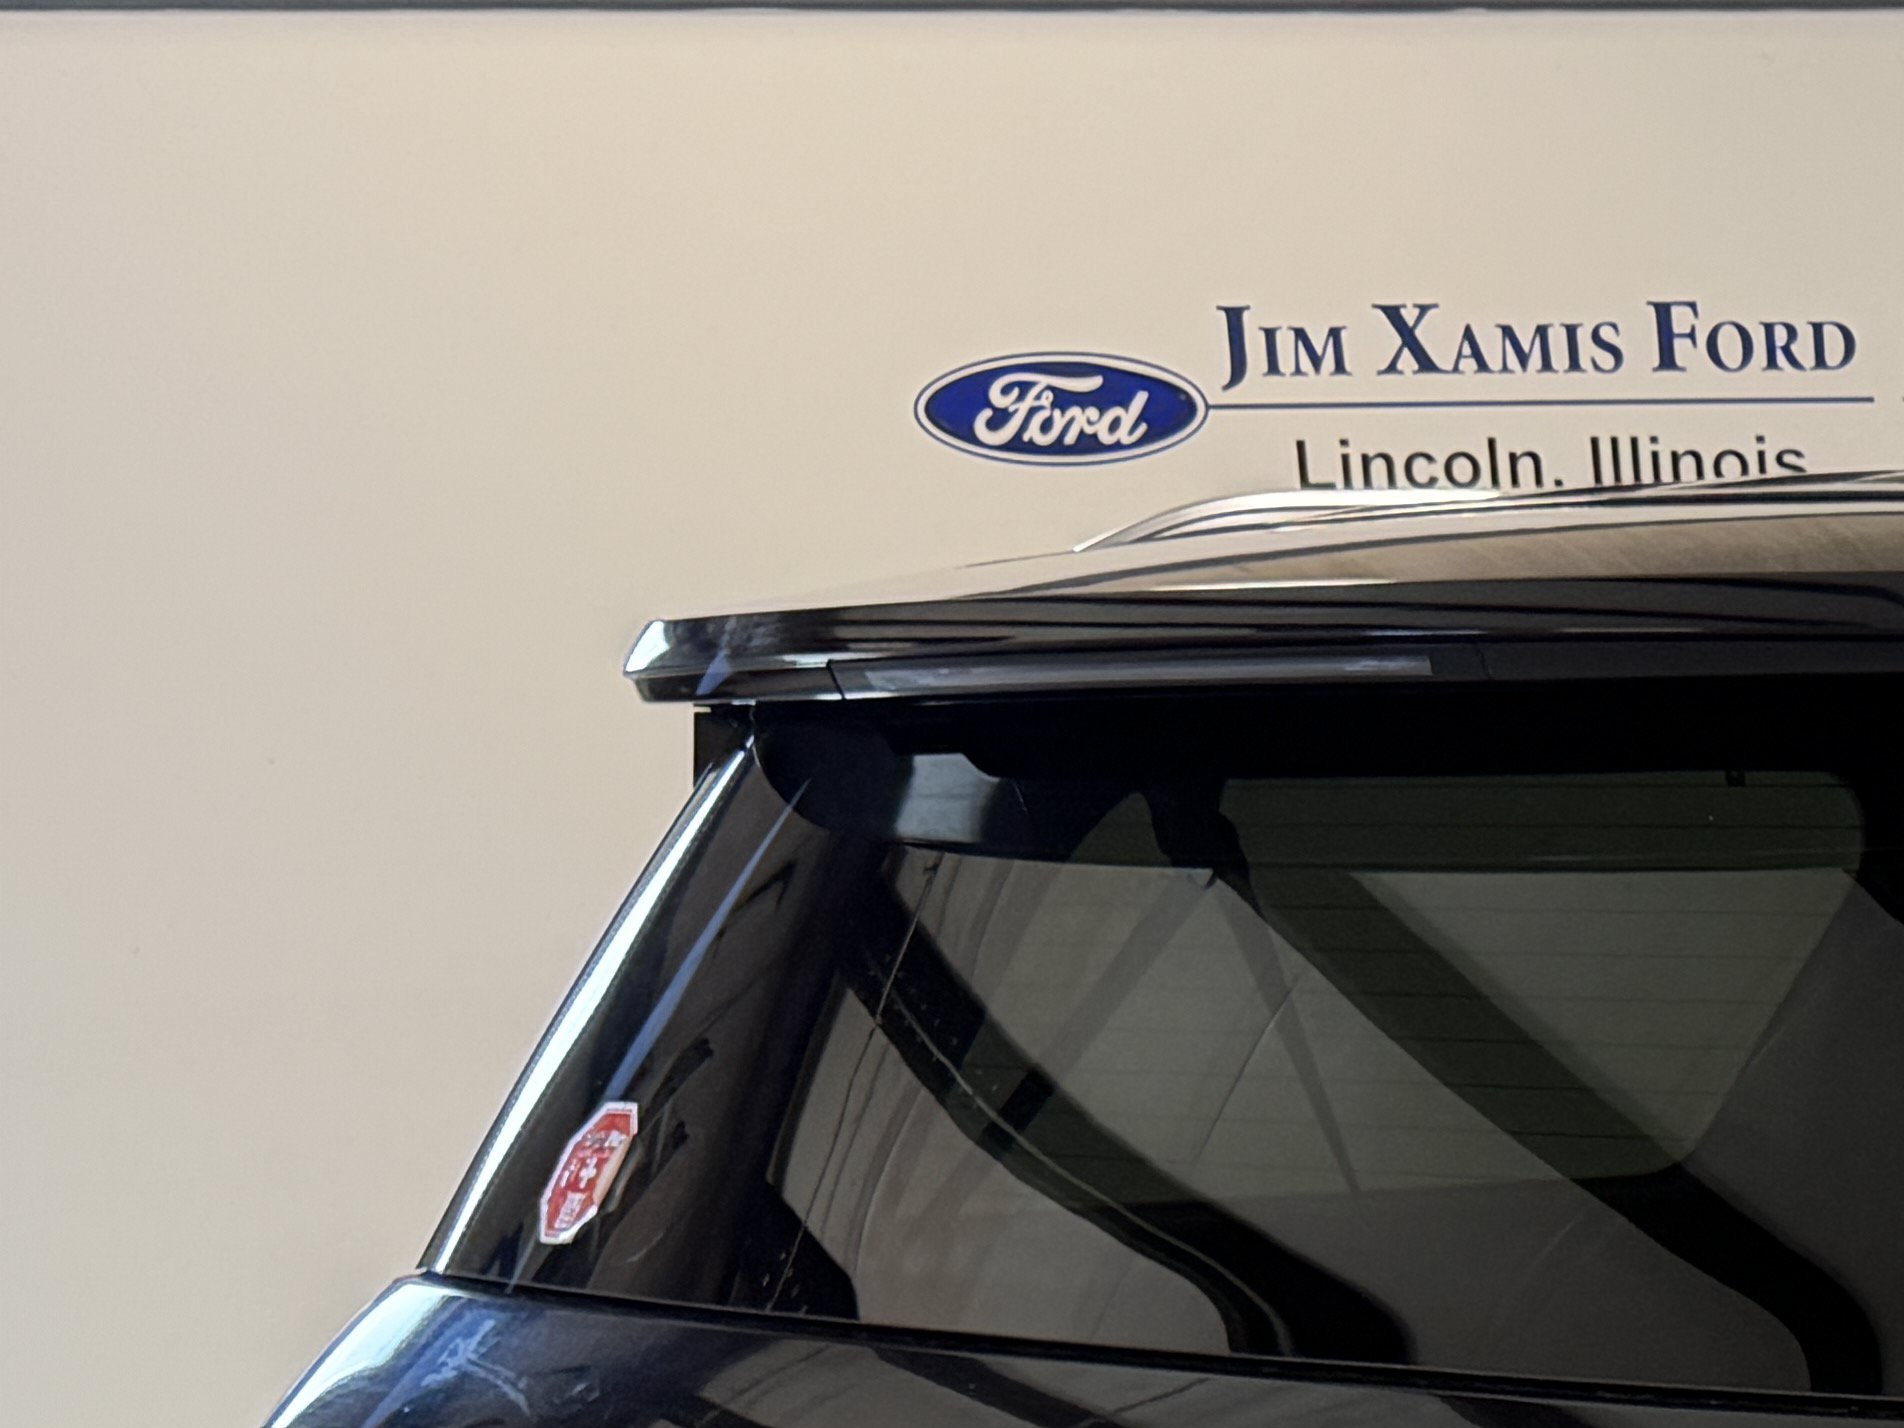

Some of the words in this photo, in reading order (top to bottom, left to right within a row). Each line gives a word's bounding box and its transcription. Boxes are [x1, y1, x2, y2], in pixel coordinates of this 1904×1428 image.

[1216, 304, 1348, 392] JIM
[1371, 302, 1625, 376] XAMIS
[1645, 300, 1857, 374] FORD
[972, 370, 1151, 447] Ford
[1589, 434, 1808, 488] Illinois
